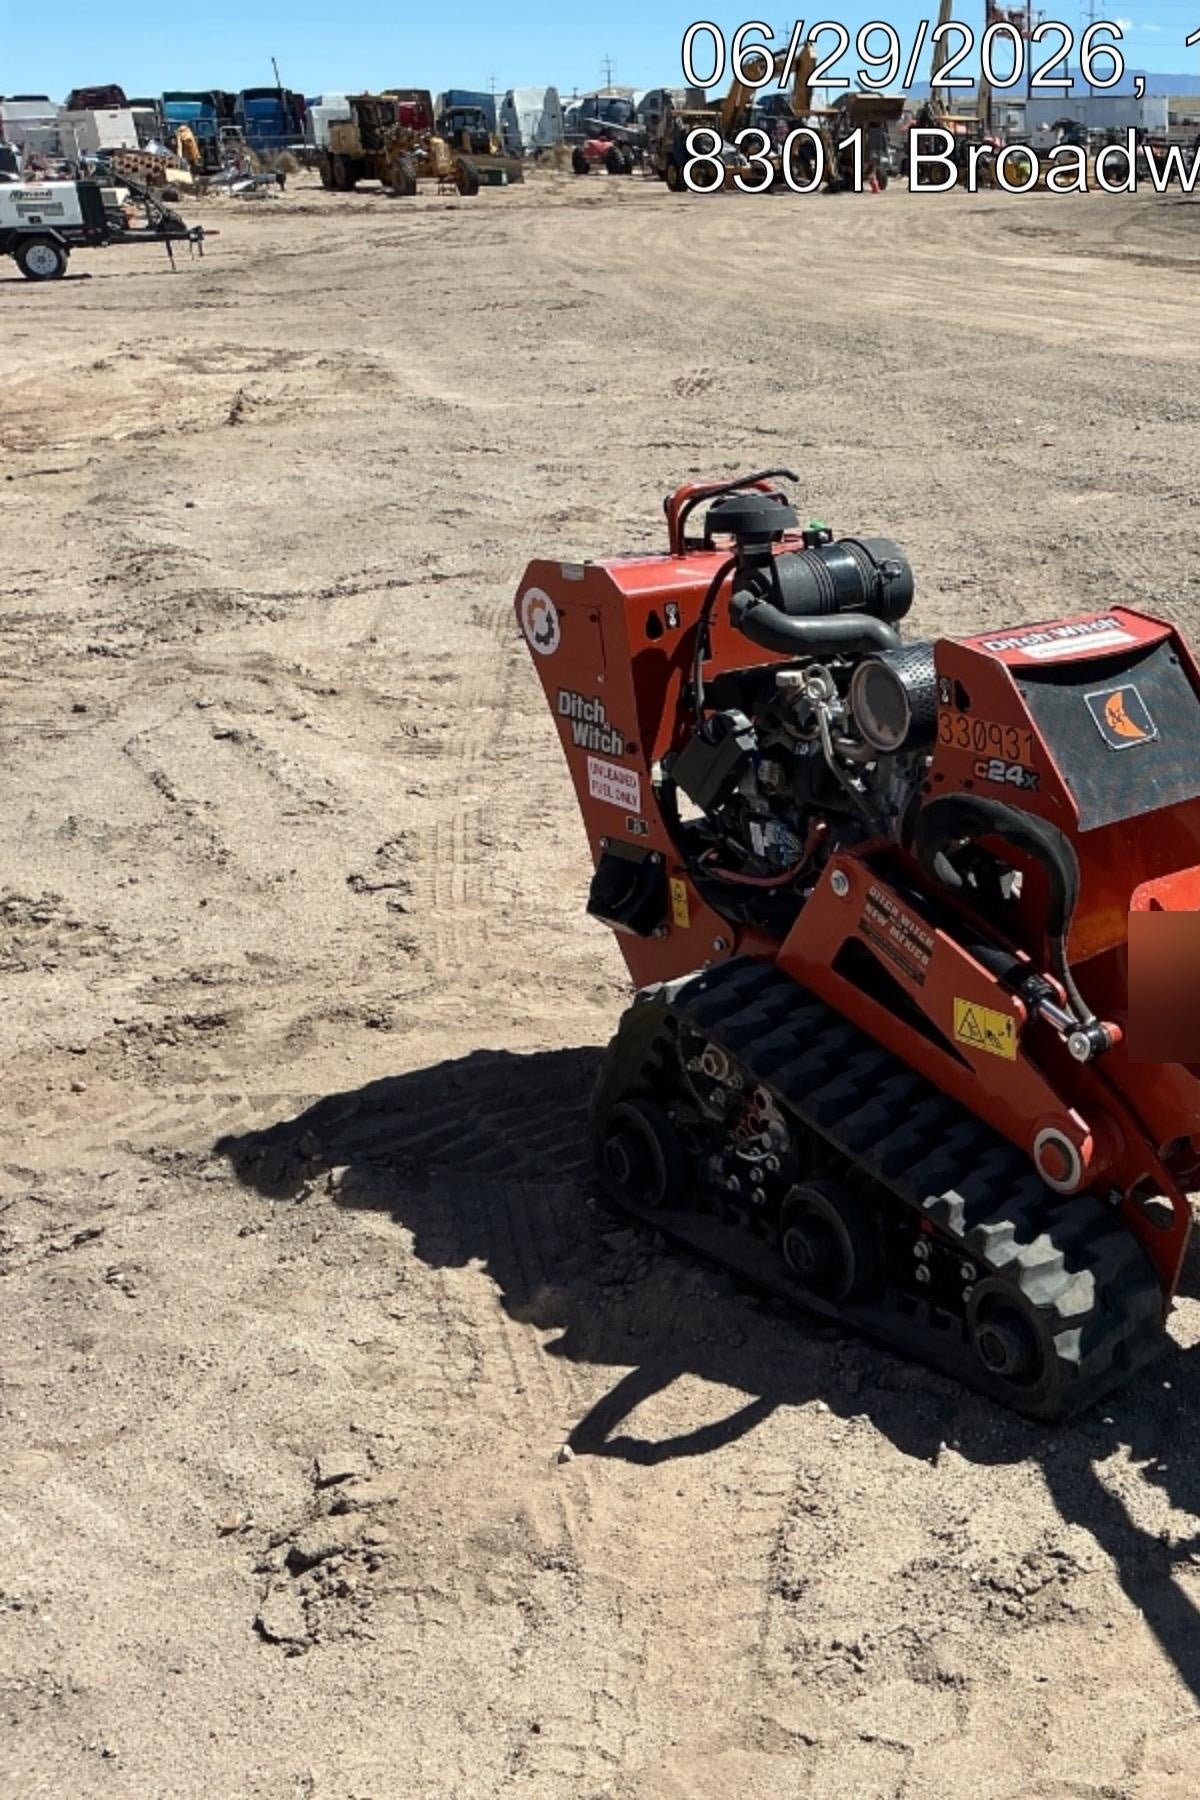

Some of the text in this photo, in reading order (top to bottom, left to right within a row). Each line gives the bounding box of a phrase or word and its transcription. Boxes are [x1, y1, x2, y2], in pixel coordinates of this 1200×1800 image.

[982, 631, 1053, 652] Ditch
[1051, 616, 1122, 638] Witch
[557, 690, 606, 723] Ditch
[572, 720, 623, 755] Witch
[939, 711, 1034, 764] 330931
